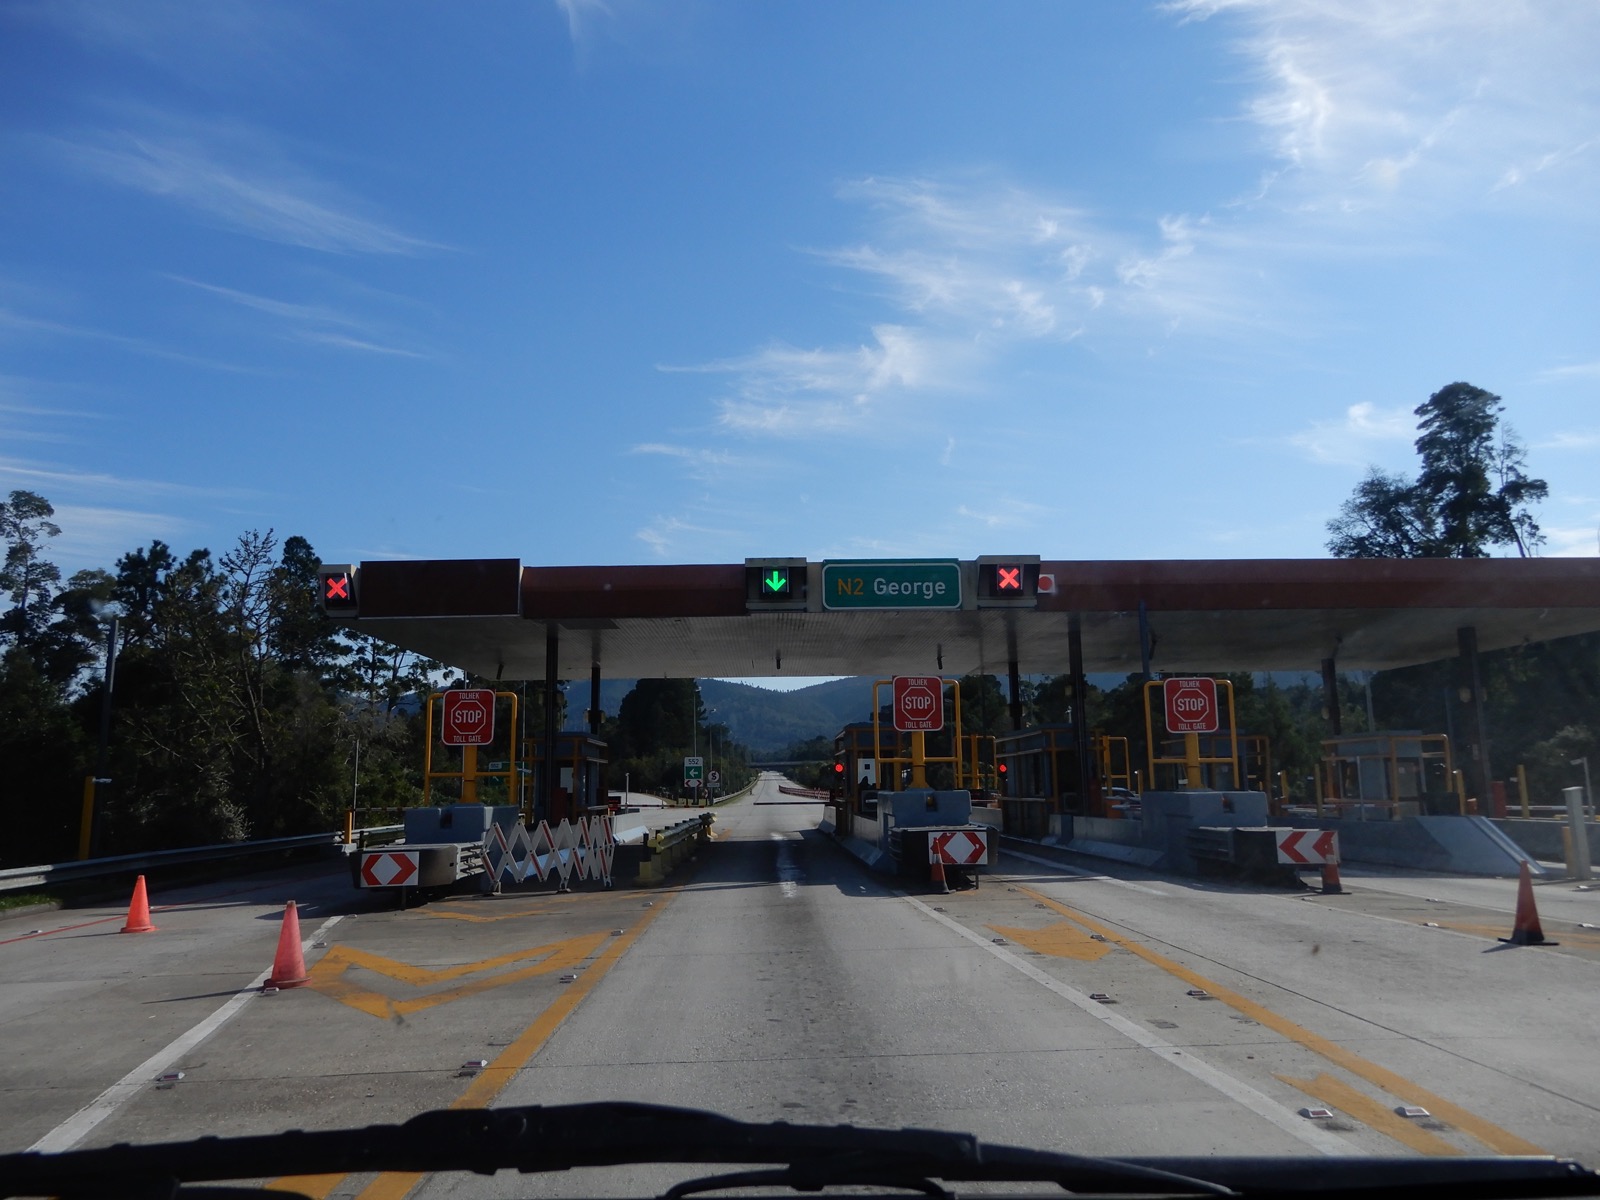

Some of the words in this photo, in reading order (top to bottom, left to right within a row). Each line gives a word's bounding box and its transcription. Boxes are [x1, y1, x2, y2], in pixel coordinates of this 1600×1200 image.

[837, 578, 864, 595] N2
[873, 577, 946, 599] George
[908, 678, 928, 686] TOLHEK
[459, 692, 480, 700] TOLHEK
[905, 696, 931, 710] STOP
[1177, 697, 1204, 711] STOP
[455, 709, 482, 723] STOP
[1192, 722, 1206, 730] GATE
[453, 735, 467, 743] TOLL
[468, 735, 482, 743] GATE
